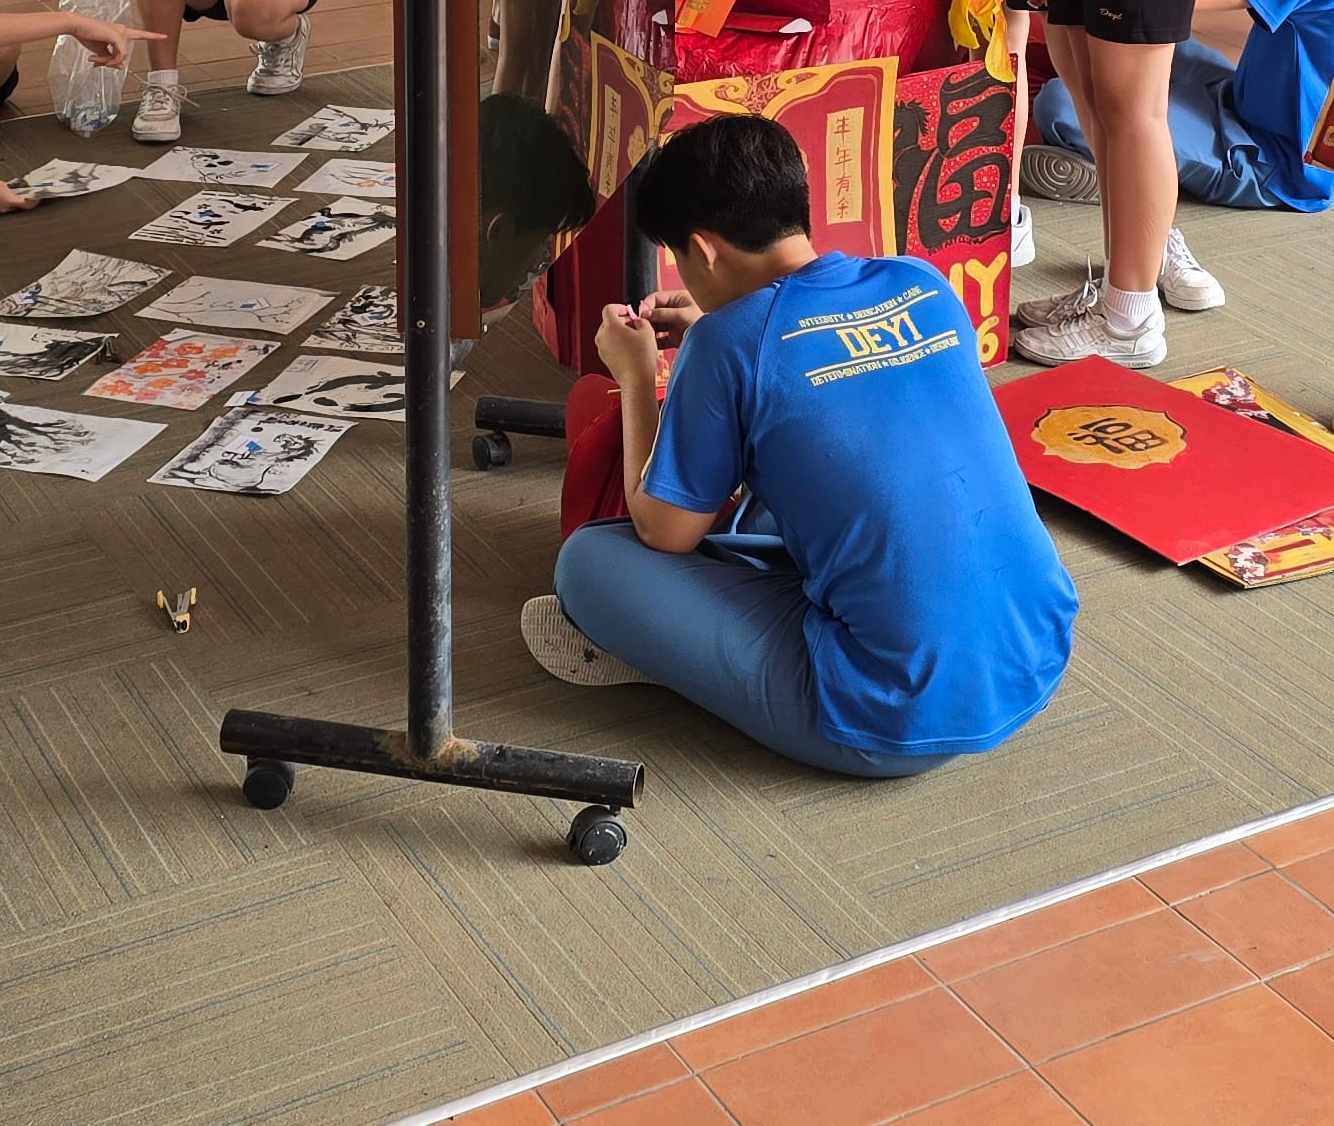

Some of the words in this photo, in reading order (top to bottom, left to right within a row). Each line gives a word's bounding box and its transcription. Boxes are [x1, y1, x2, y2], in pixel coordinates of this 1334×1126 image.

[833, 115, 853, 220] 年年有余
[798, 313, 845, 328] INTEGRITY
[835, 310, 924, 358] DEYI
[810, 360, 883, 387] DETERMINATION
[1067, 417, 1169, 454] 福
